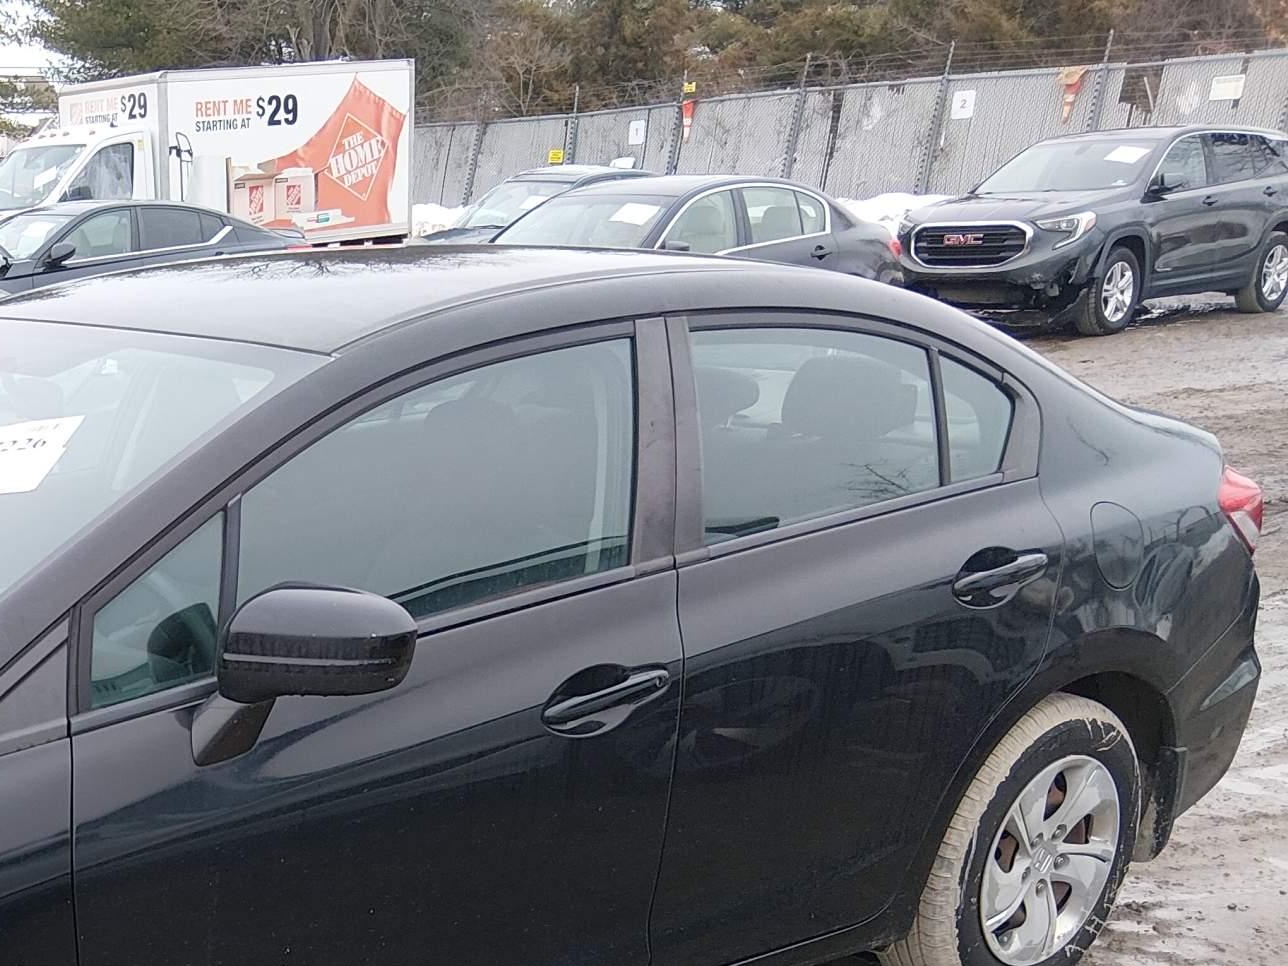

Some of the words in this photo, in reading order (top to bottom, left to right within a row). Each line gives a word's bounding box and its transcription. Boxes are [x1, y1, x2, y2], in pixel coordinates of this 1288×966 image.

[120, 92, 148, 120] $29
[195, 100, 229, 118] RENT
[233, 98, 252, 115] ME
[256, 94, 298, 126] $29
[959, 98, 968, 109] 2
[85, 112, 110, 124] STARTING
[195, 118, 238, 132] STARTING
[240, 117, 251, 129] AT
[341, 131, 365, 150] THE
[330, 137, 385, 177] HOME
[343, 161, 377, 187] DEPOT
[943, 233, 984, 246] GMC
